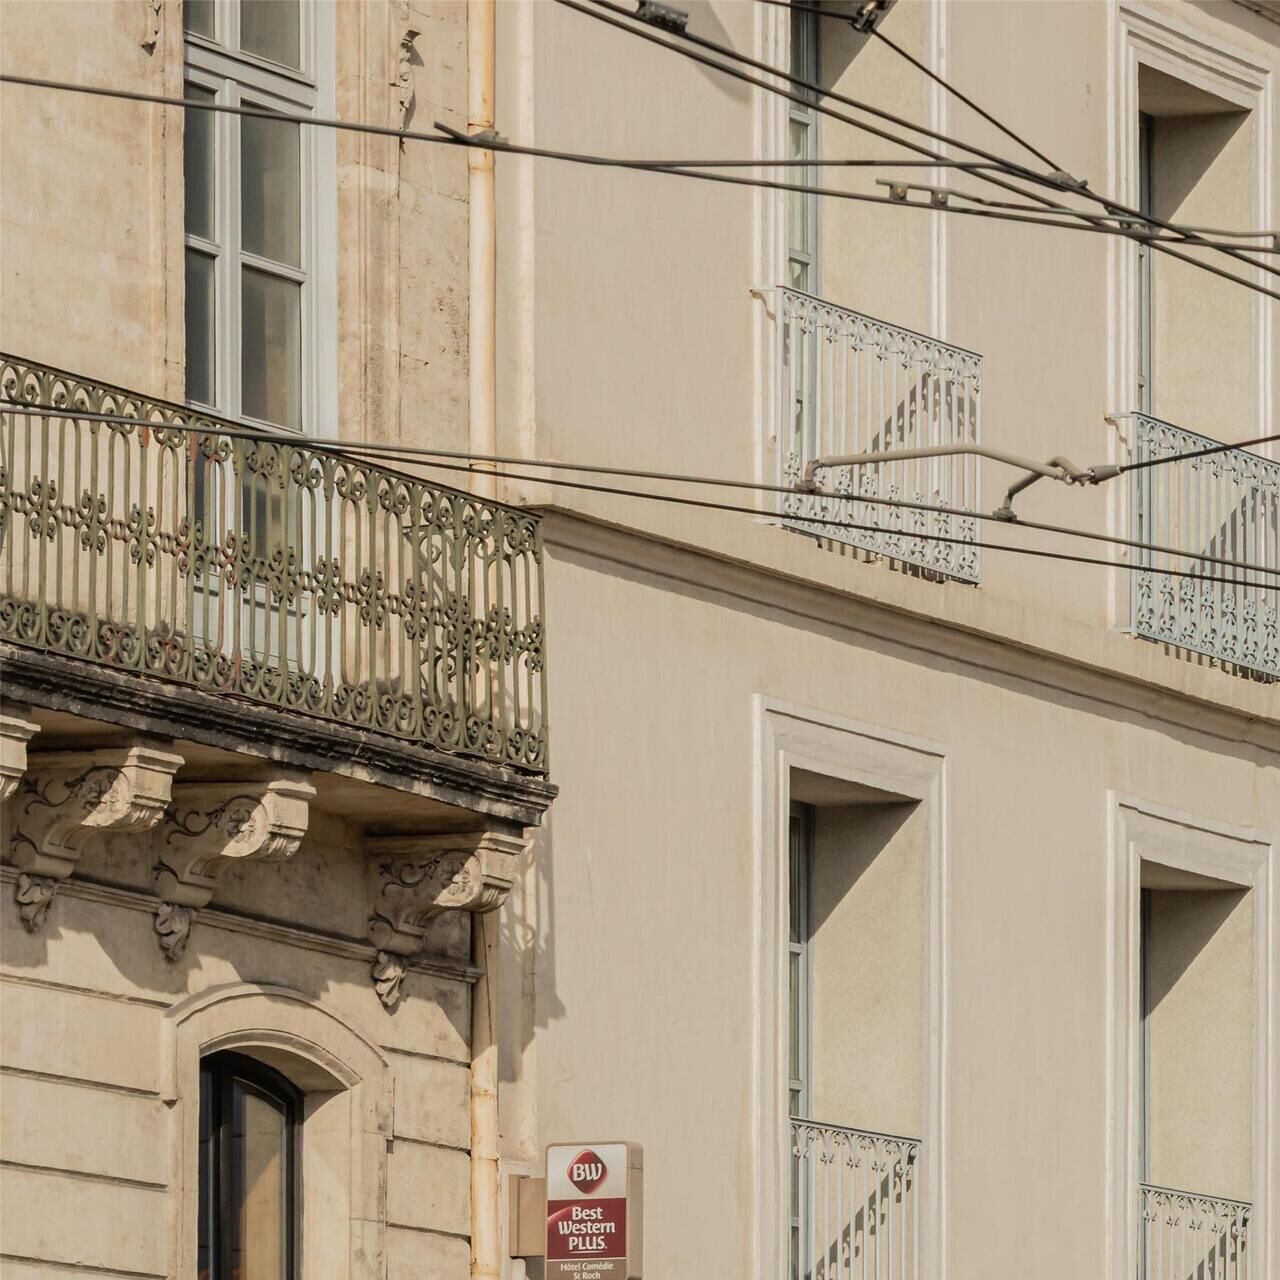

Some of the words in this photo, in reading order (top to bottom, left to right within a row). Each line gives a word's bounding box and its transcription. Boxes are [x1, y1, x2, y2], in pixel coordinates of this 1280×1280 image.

[572, 1163, 602, 1181] BW
[571, 1206, 603, 1220] Best
[558, 1220, 616, 1235] Western
[569, 1236, 605, 1250] PLUS
[560, 1263, 581, 1271] Hôtel
[582, 1262, 614, 1271] Comédie
[573, 1272, 581, 1280] St
[582, 1271, 601, 1279] Roch
